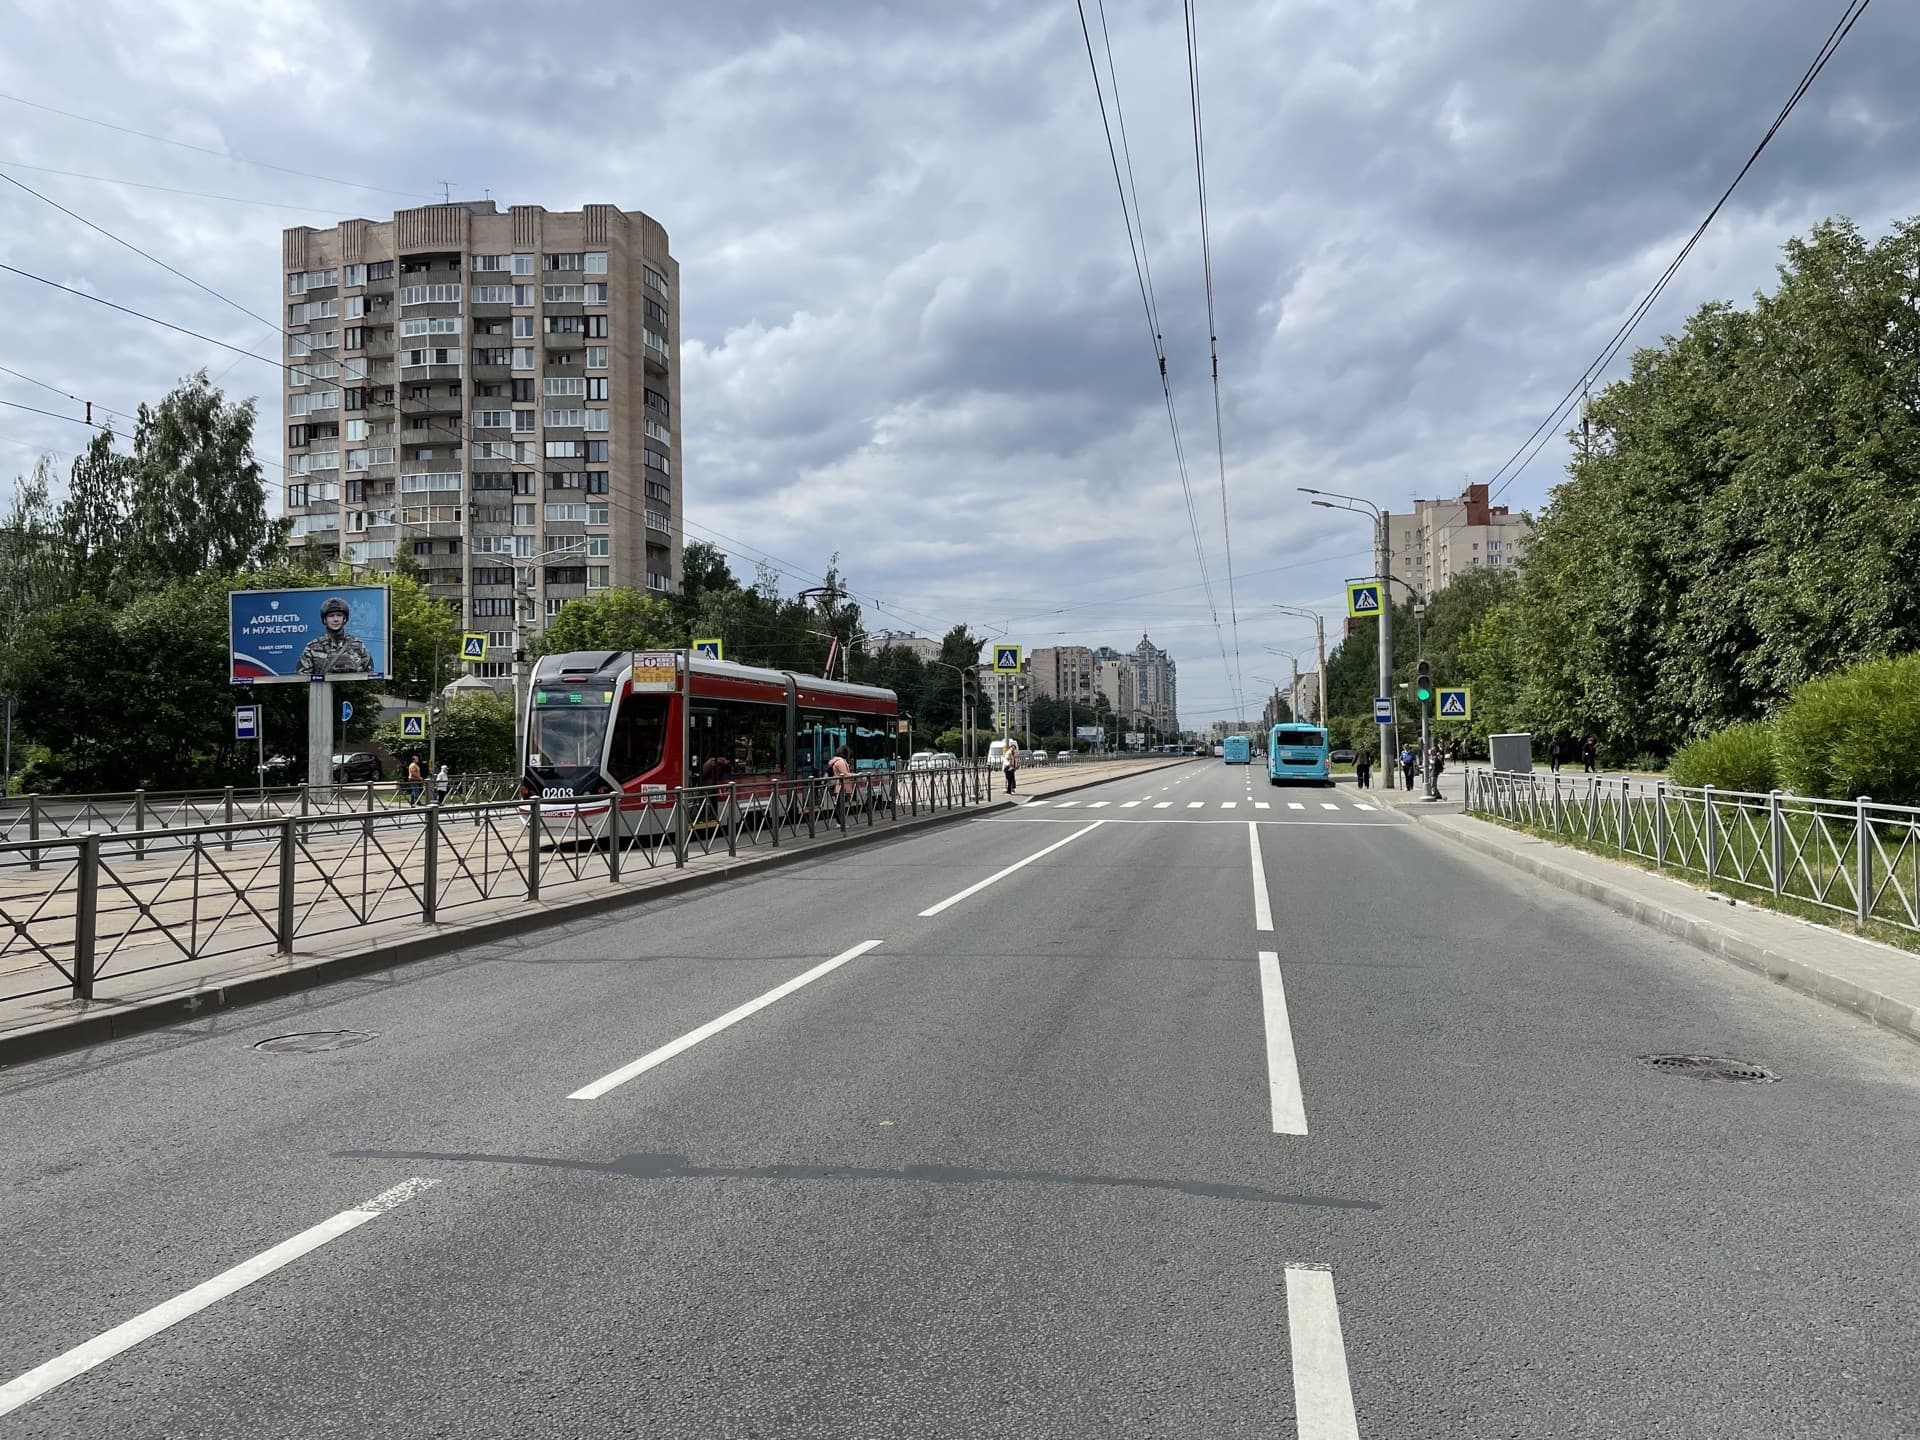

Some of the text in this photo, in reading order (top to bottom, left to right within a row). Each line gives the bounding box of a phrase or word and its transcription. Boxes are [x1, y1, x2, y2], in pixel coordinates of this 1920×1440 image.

[250, 614, 300, 624] ДОБЛЕСТЬ
[252, 624, 308, 634] МУЖЕСТВО!
[542, 787, 574, 799] 0203
